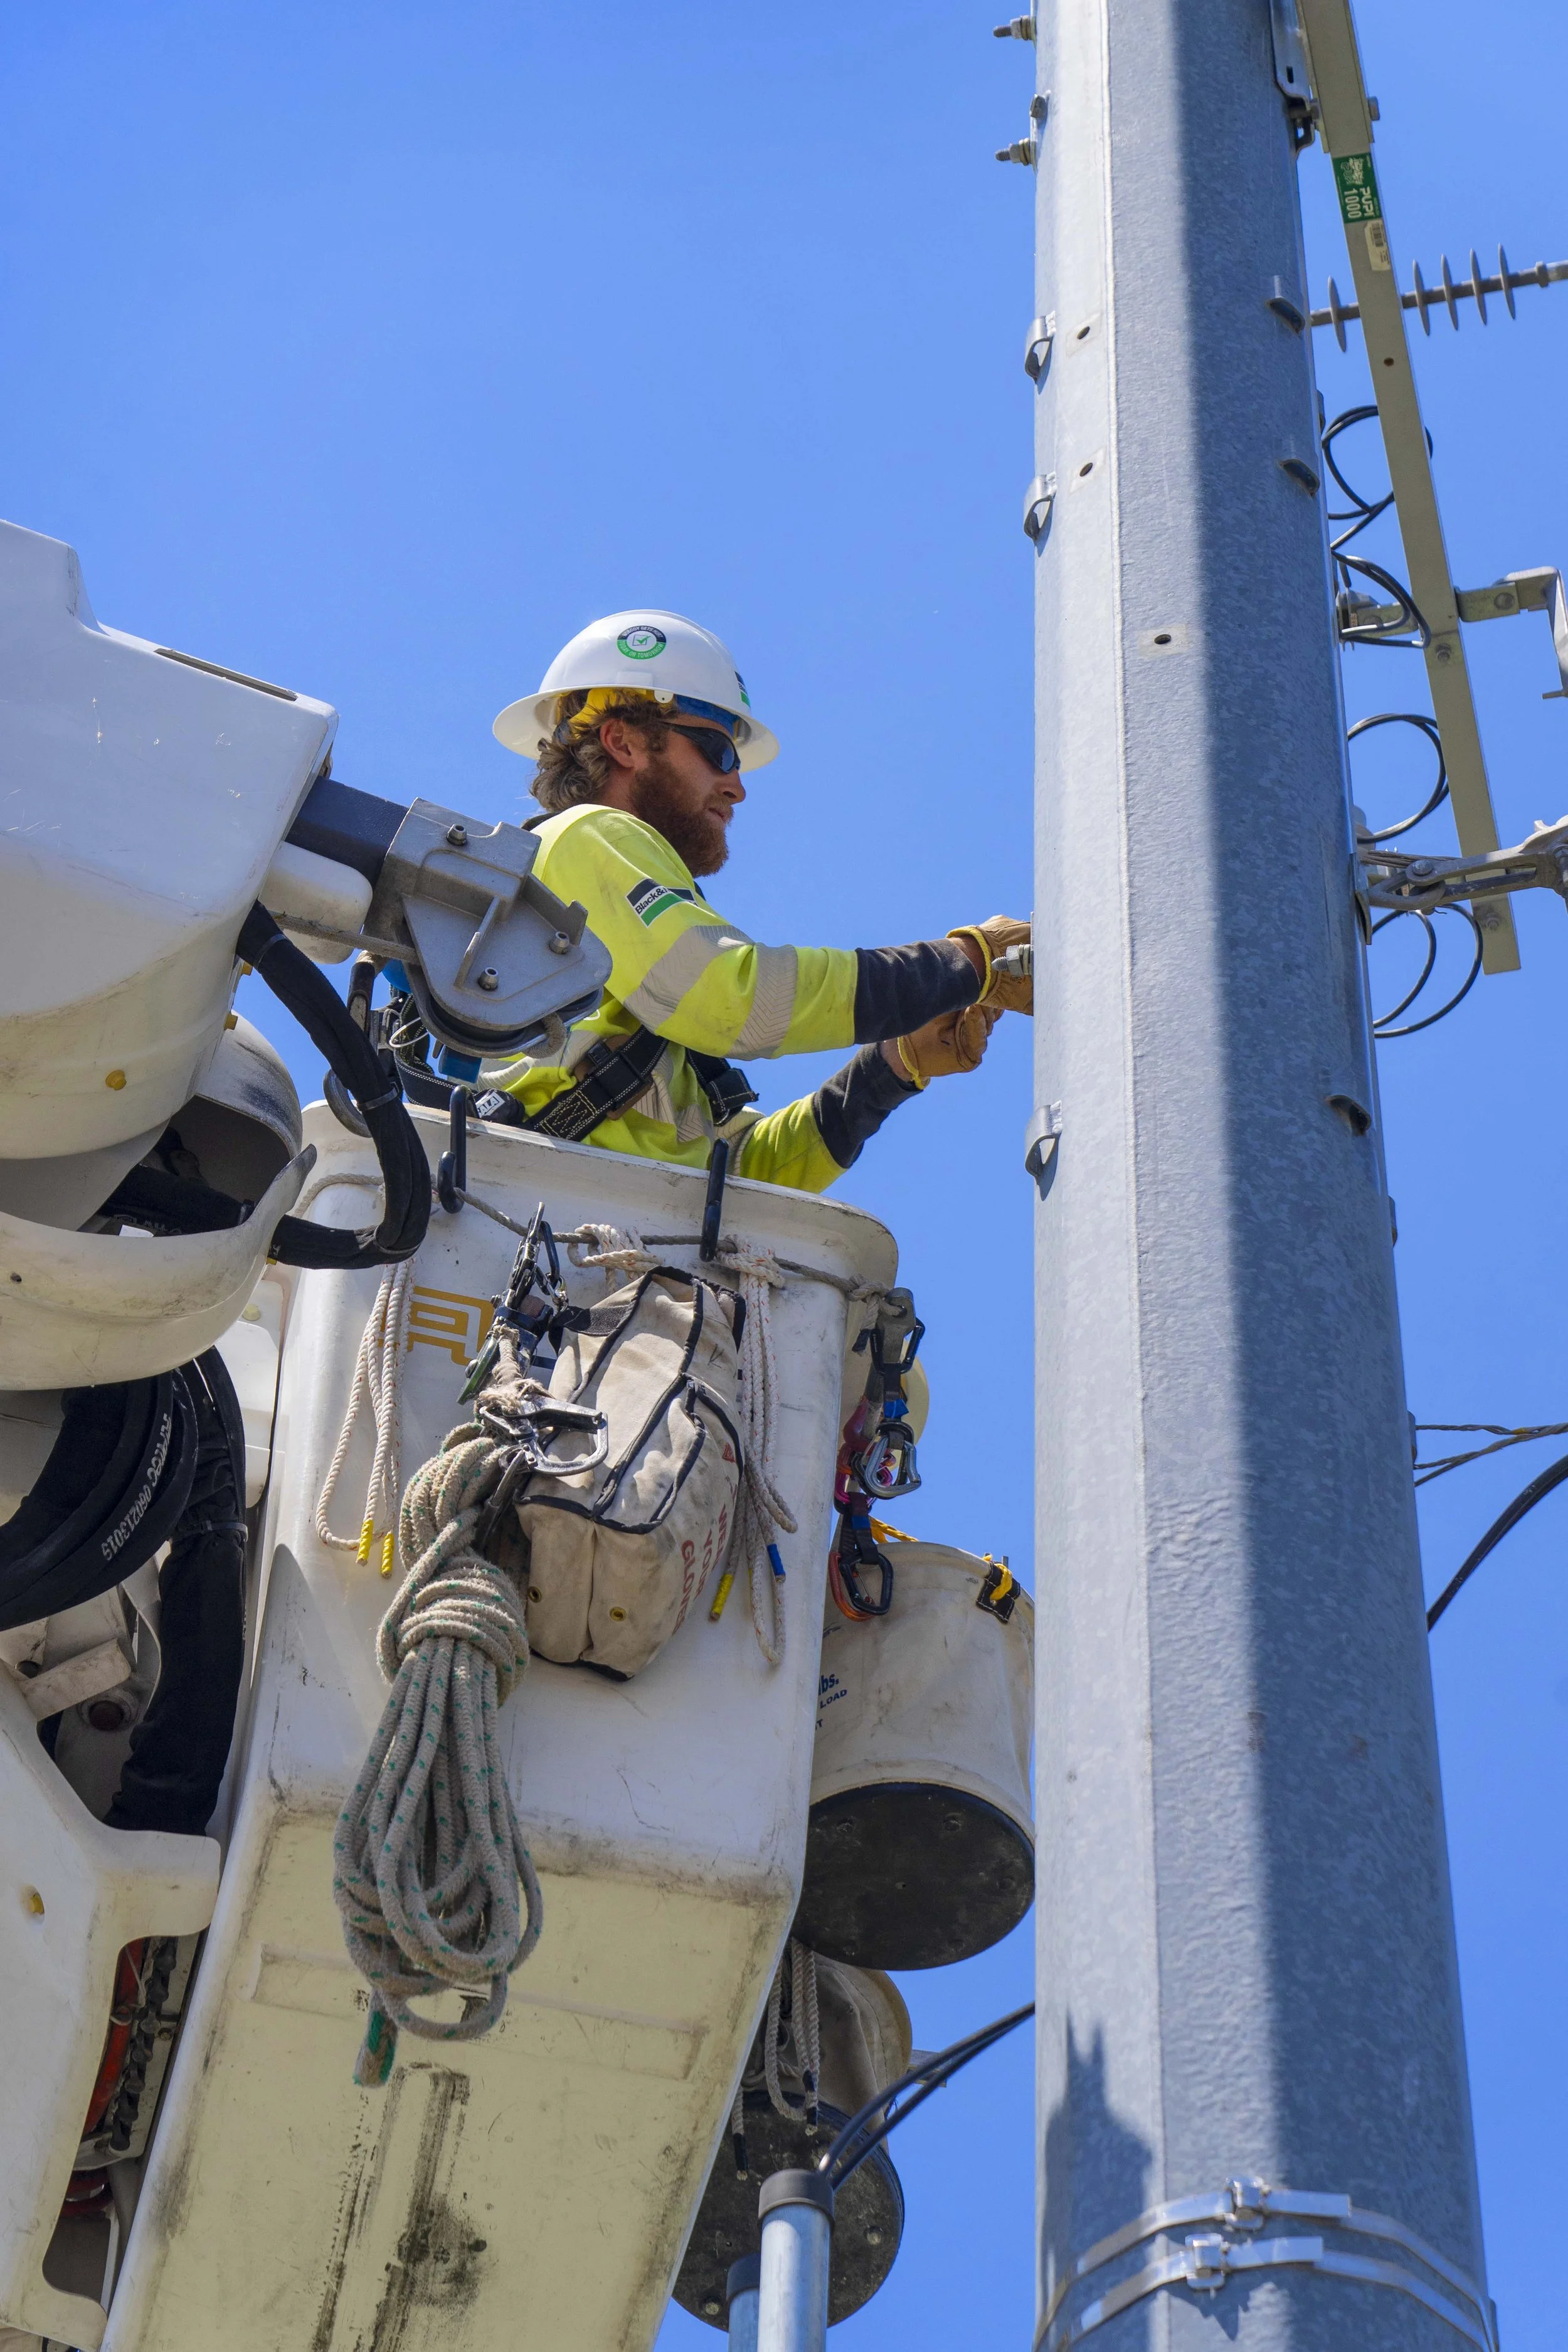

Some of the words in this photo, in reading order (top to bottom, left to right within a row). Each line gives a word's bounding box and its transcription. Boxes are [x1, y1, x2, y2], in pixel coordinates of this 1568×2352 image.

[1344, 188, 1362, 219] 1000
[1360, 186, 1375, 217] PUPI
[622, 627, 640, 636] NOBODY
[619, 640, 630, 653] TODAY
[637, 642, 664, 658] TOMORROW
[820, 1690, 847, 1709] LOAD
